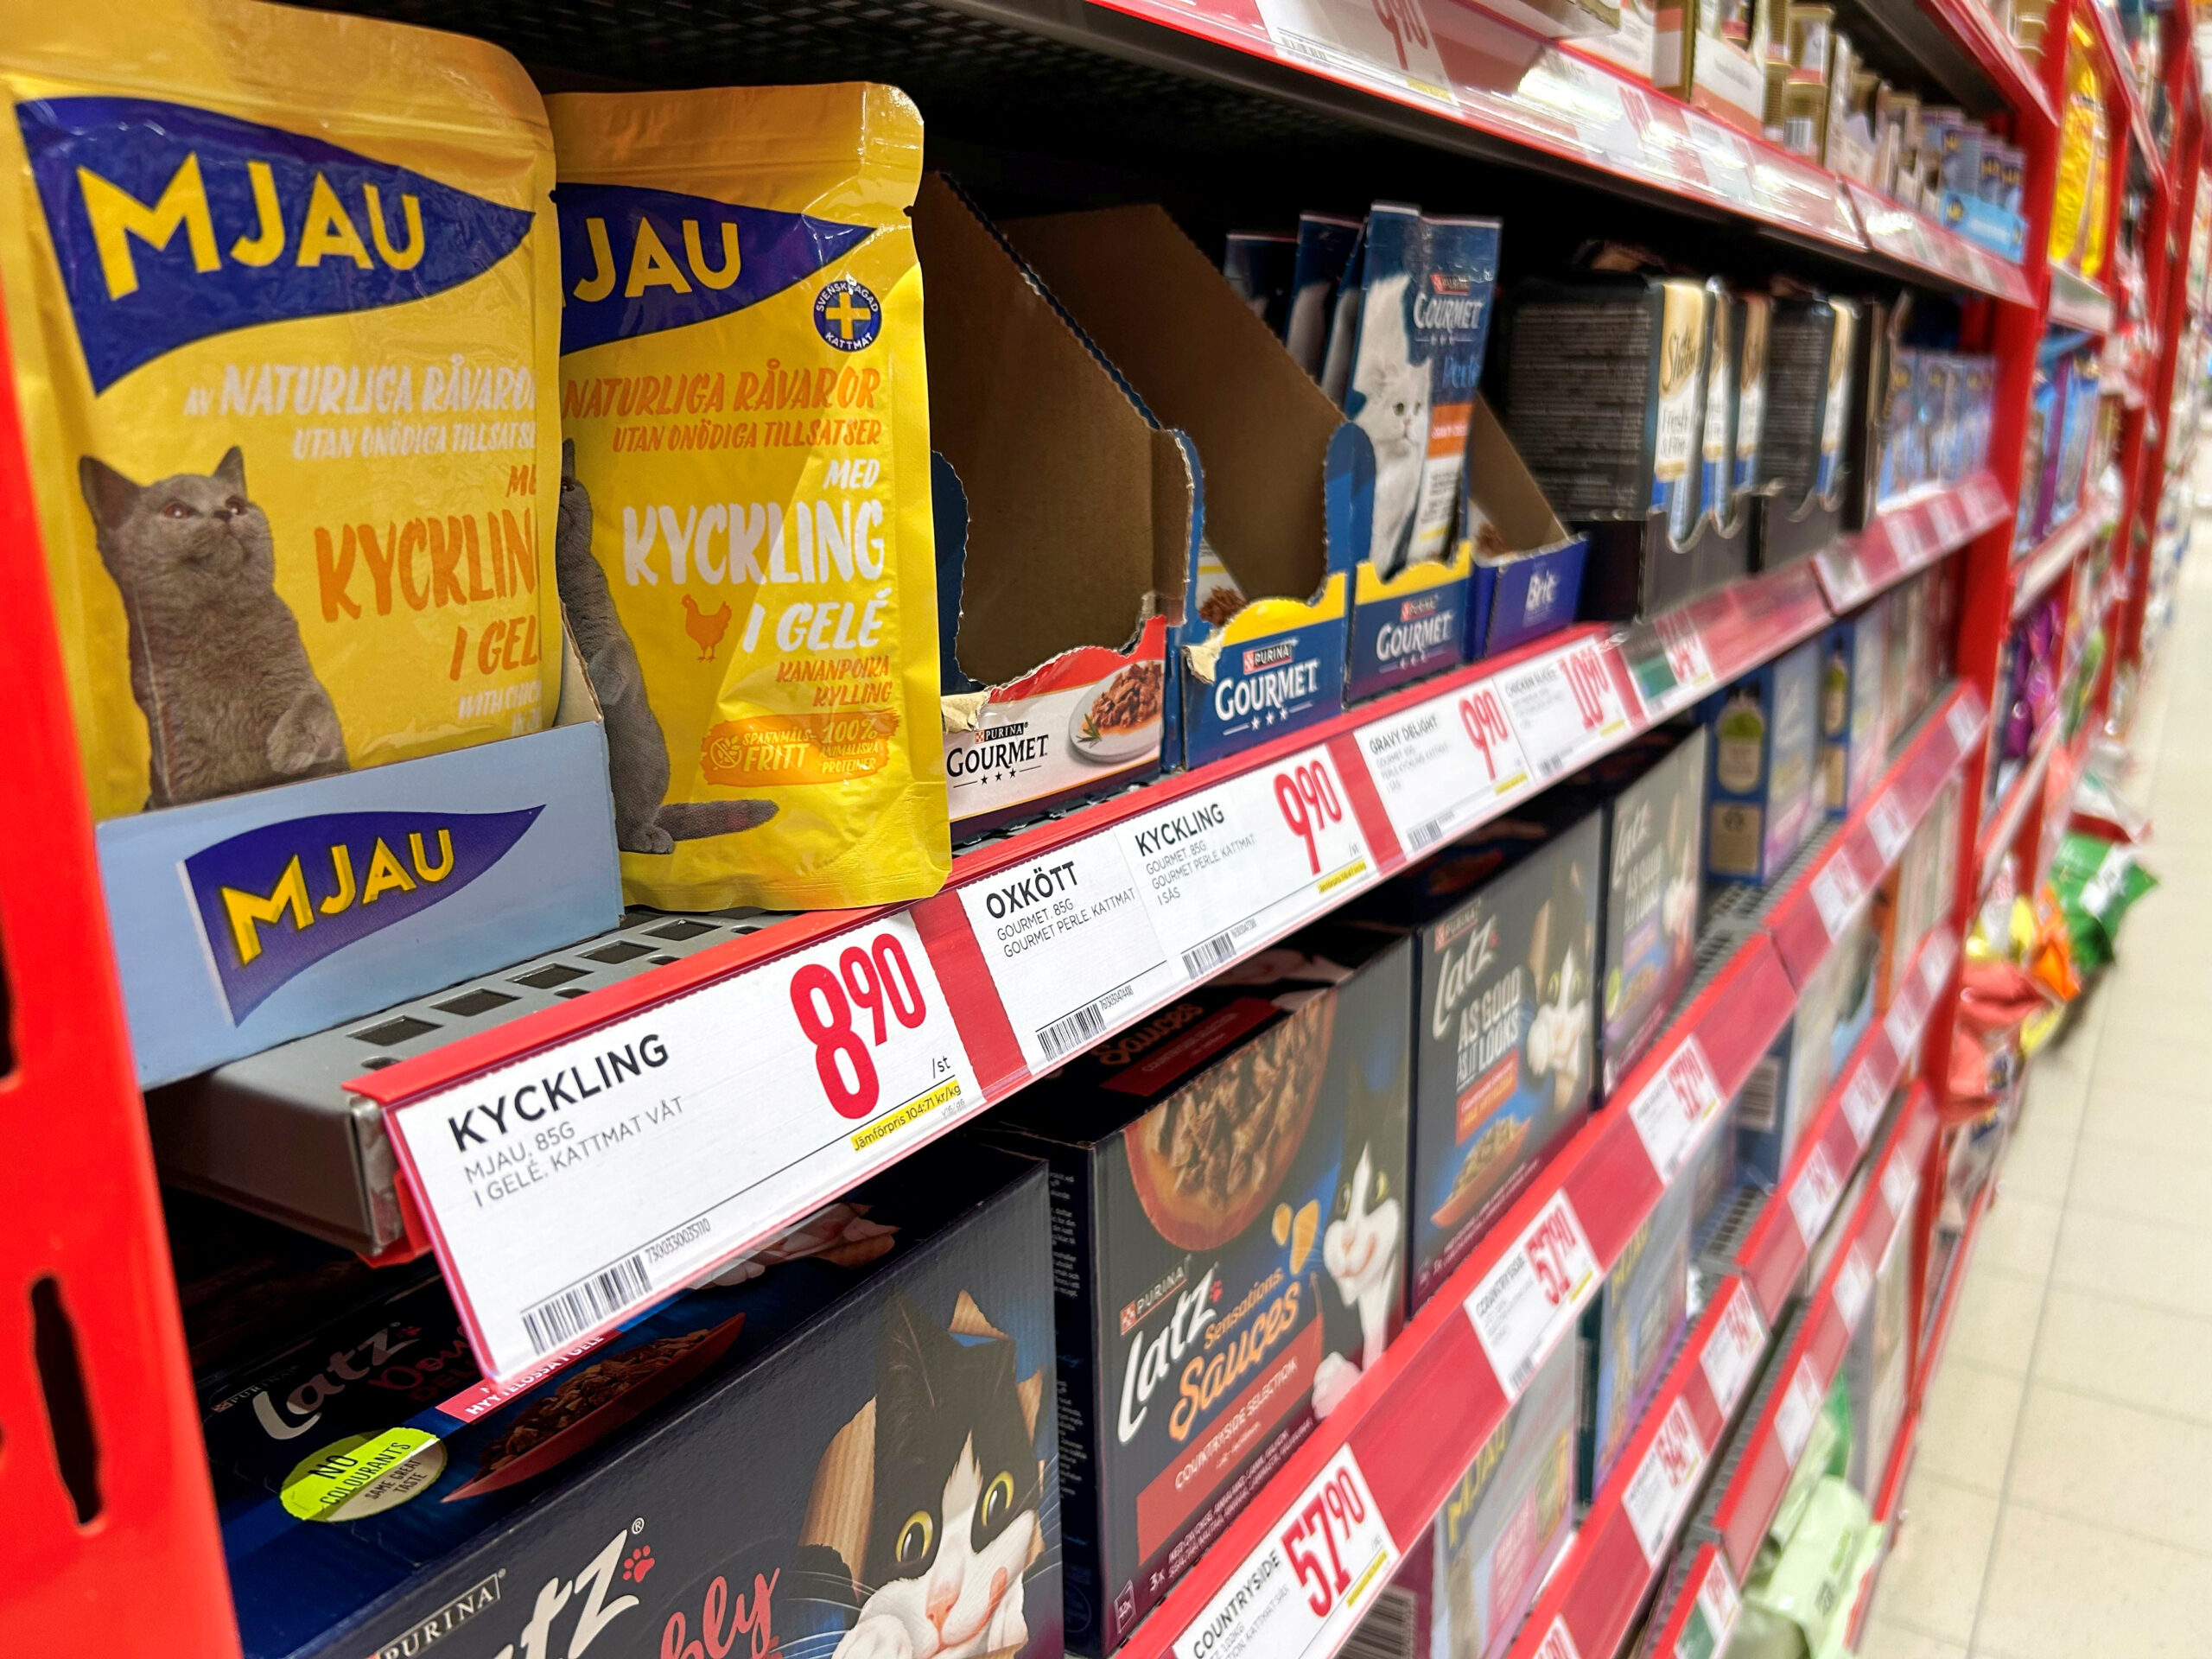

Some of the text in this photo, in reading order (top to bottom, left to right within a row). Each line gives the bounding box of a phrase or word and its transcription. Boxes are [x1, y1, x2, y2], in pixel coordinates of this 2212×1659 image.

[77, 152, 426, 302] MJAU
[563, 217, 741, 308] JAU
[825, 332, 873, 349] KATTMAT
[1414, 292, 1484, 334] GOURMET
[183, 385, 215, 417] AV
[219, 364, 412, 416] NATURLIGA
[563, 358, 880, 420] NATURLIGA RÅVAROR
[292, 428, 360, 461] UTAN
[360, 425, 448, 458] ONÖDIGA
[613, 416, 881, 453] UTAN ONÖDIGA TILLSATSER
[506, 463, 537, 500] ME
[823, 459, 880, 490] MED
[314, 508, 538, 624] KYCKLIN
[622, 499, 885, 587] KYCKLING
[450, 615, 539, 681] I GEL
[741, 588, 893, 653] I GELÉ
[1376, 609, 1454, 661] GOURMET
[776, 655, 890, 683] KANANPOIKA
[1255, 645, 1291, 666] PURINA
[812, 681, 893, 707] KYLLING
[1215, 660, 1319, 721] GOURMET
[743, 742, 810, 772] FRITT
[820, 741, 879, 758] ANIMALISKA
[821, 718, 879, 744] 100%
[946, 734, 1049, 779] GOURMET
[985, 723, 1024, 741] PURINA
[1369, 714, 1439, 755] GRAVY DELIGHT
[1459, 690, 1508, 781] 990
[822, 757, 876, 773] PROTEINER
[1135, 803, 1224, 856] KYCKLING
[1190, 840, 1207, 855] 85G
[1274, 760, 1342, 876] 990
[986, 861, 1077, 918] OXKÖTT
[1152, 862, 1193, 889] GOURMET
[1221, 833, 1256, 858] KATTMAT
[220, 829, 454, 968] MJAU
[1003, 924, 1056, 957] GOURMET
[1091, 887, 1136, 916] KATTMAT
[1053, 898, 1074, 916] 85G
[1433, 914, 1496, 1040] Latz
[790, 933, 926, 1119] 890
[1458, 964, 1522, 1053] AS GOOD
[1478, 1007, 1520, 1069] LOOKS
[448, 1034, 669, 1153] KYCKLING
[931, 1055, 950, 1078] /st
[535, 1121, 575, 1152] 85G
[854, 1082, 962, 1152] Jämförpris 104:71 kr/kg
[474, 1190, 483, 1208] I
[550, 1116, 642, 1172] KATTMAT
[646, 1096, 683, 1125] VÅT
[1136, 1268, 1185, 1315] PURINA
[1204, 1268, 1283, 1351] Sensations
[253, 1328, 421, 1440] Latz
[1118, 1269, 1216, 1446] Latz
[1170, 1282, 1300, 1441] Sauces
[1175, 1407, 1246, 1490] COUNTRYSIDE
[1247, 1356, 1297, 1417] SELECTION
[308, 1454, 358, 1480] NO
[320, 1442, 411, 1506] COLOURANTS
[365, 1459, 422, 1500] SAME GREAT
[392, 1471, 428, 1495] TASTE
[1281, 1466, 1364, 1618] 5790
[381, 1586, 494, 1659] PURINA
[486, 1529, 639, 1659] tz
[1194, 1549, 1281, 1659] COUNTRYSIDE
